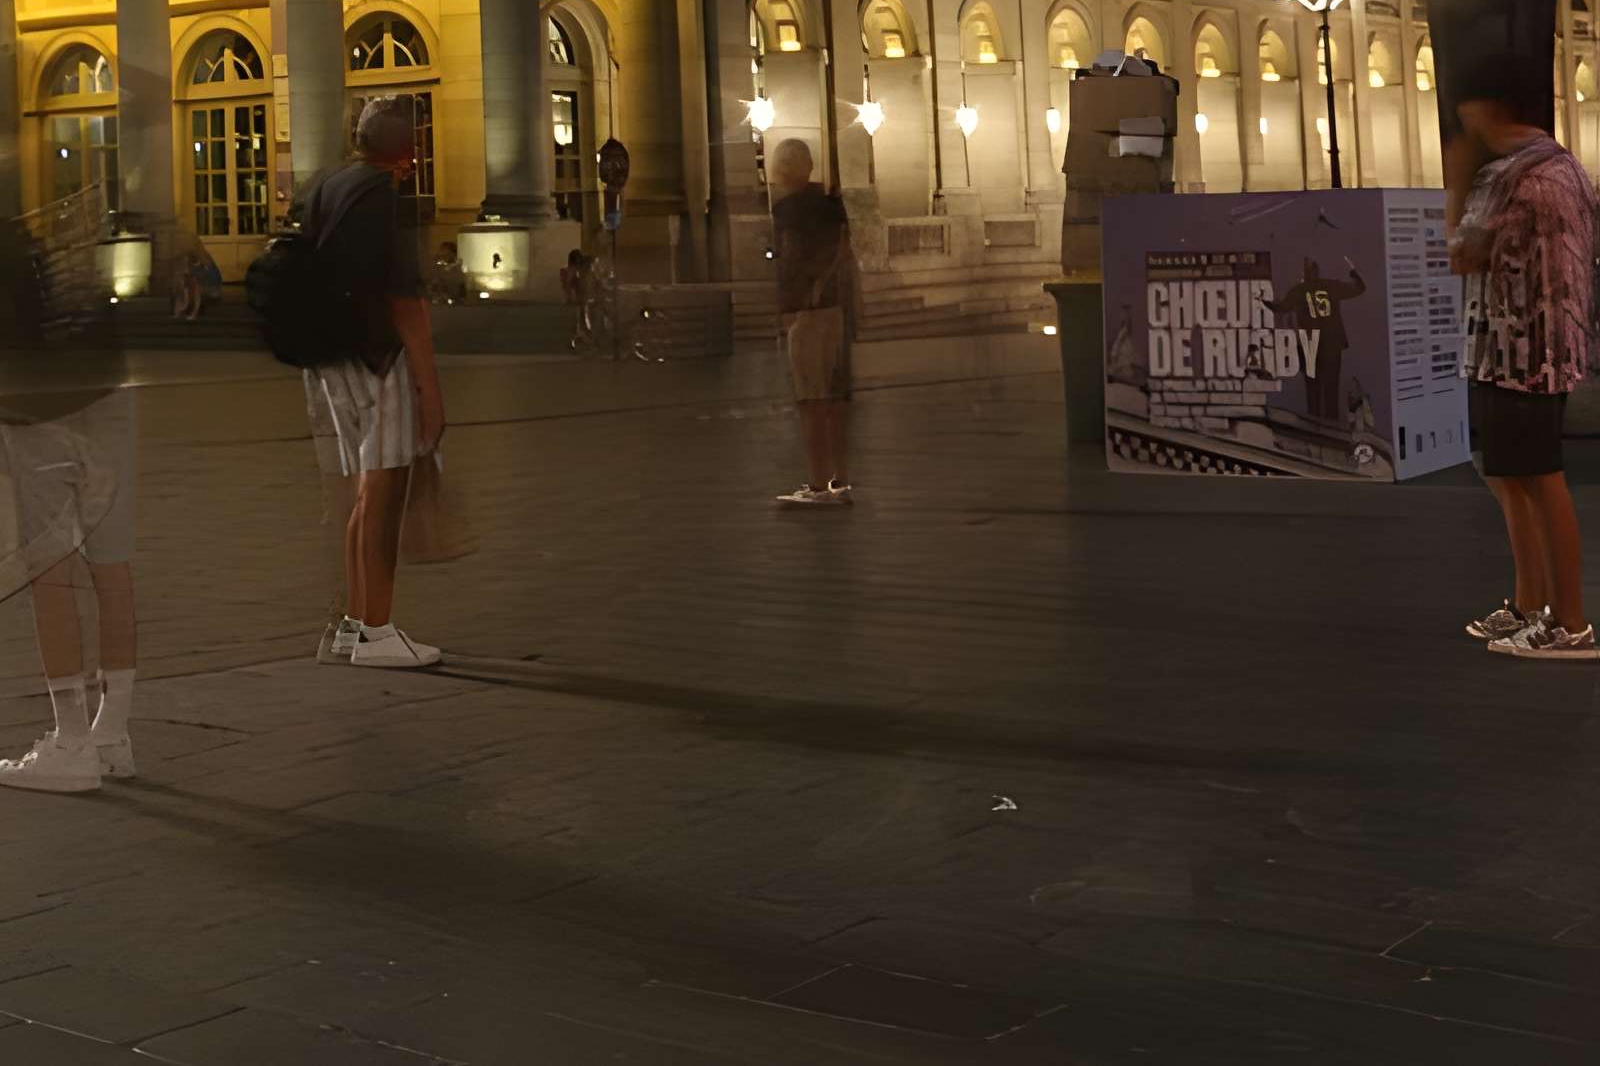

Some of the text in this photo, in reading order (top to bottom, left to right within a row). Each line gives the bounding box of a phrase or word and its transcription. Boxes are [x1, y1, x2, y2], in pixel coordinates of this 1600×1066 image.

[1147, 280, 1274, 328] CHŒUR
[1306, 290, 1332, 319] 15
[1149, 329, 1321, 378] DE RUGBY
